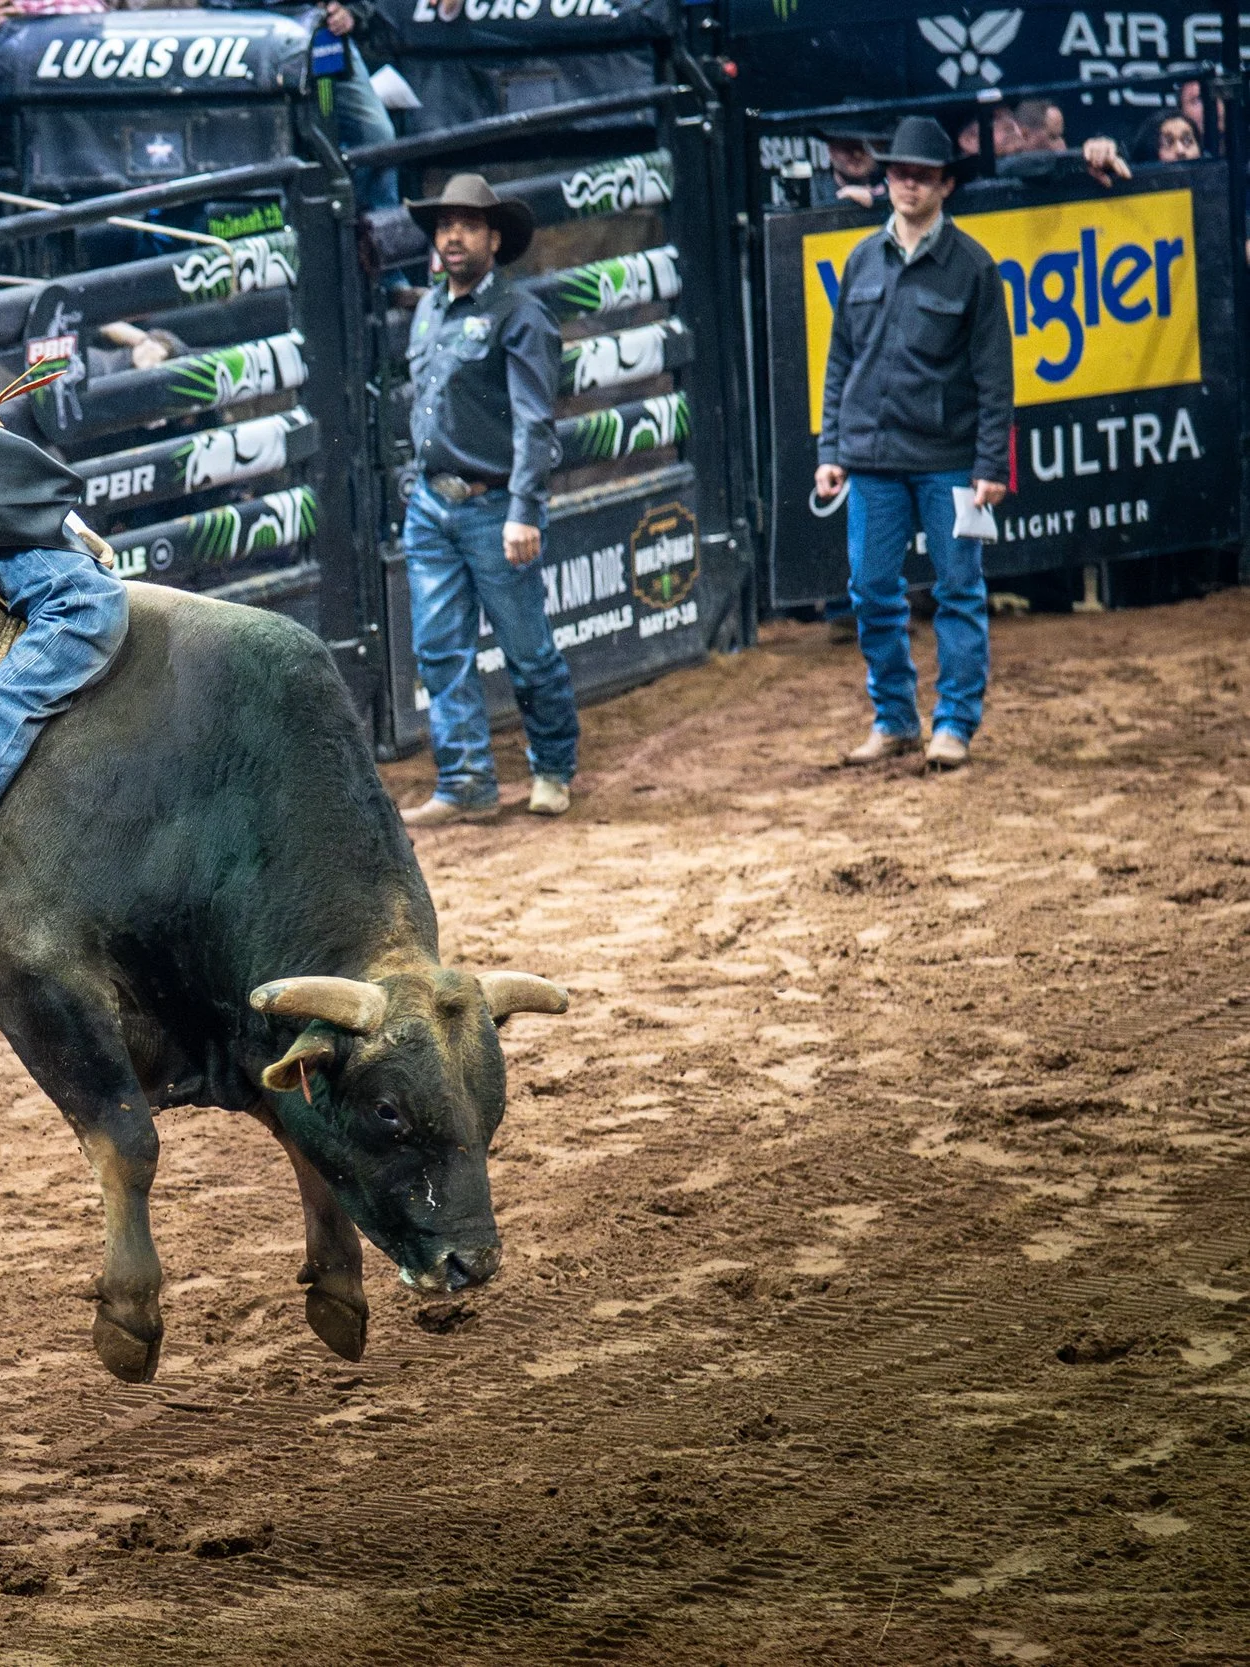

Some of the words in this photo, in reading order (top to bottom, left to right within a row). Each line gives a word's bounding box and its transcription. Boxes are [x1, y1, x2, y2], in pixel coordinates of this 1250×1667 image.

[1059, 11, 1169, 58] AIR
[37, 37, 179, 79] LUCAS
[29, 336, 77, 363] PBR
[1031, 407, 1201, 482] ULTRA
[85, 465, 156, 506] PBR
[1004, 509, 1076, 542] LIGHT
[561, 554, 592, 612] AND
